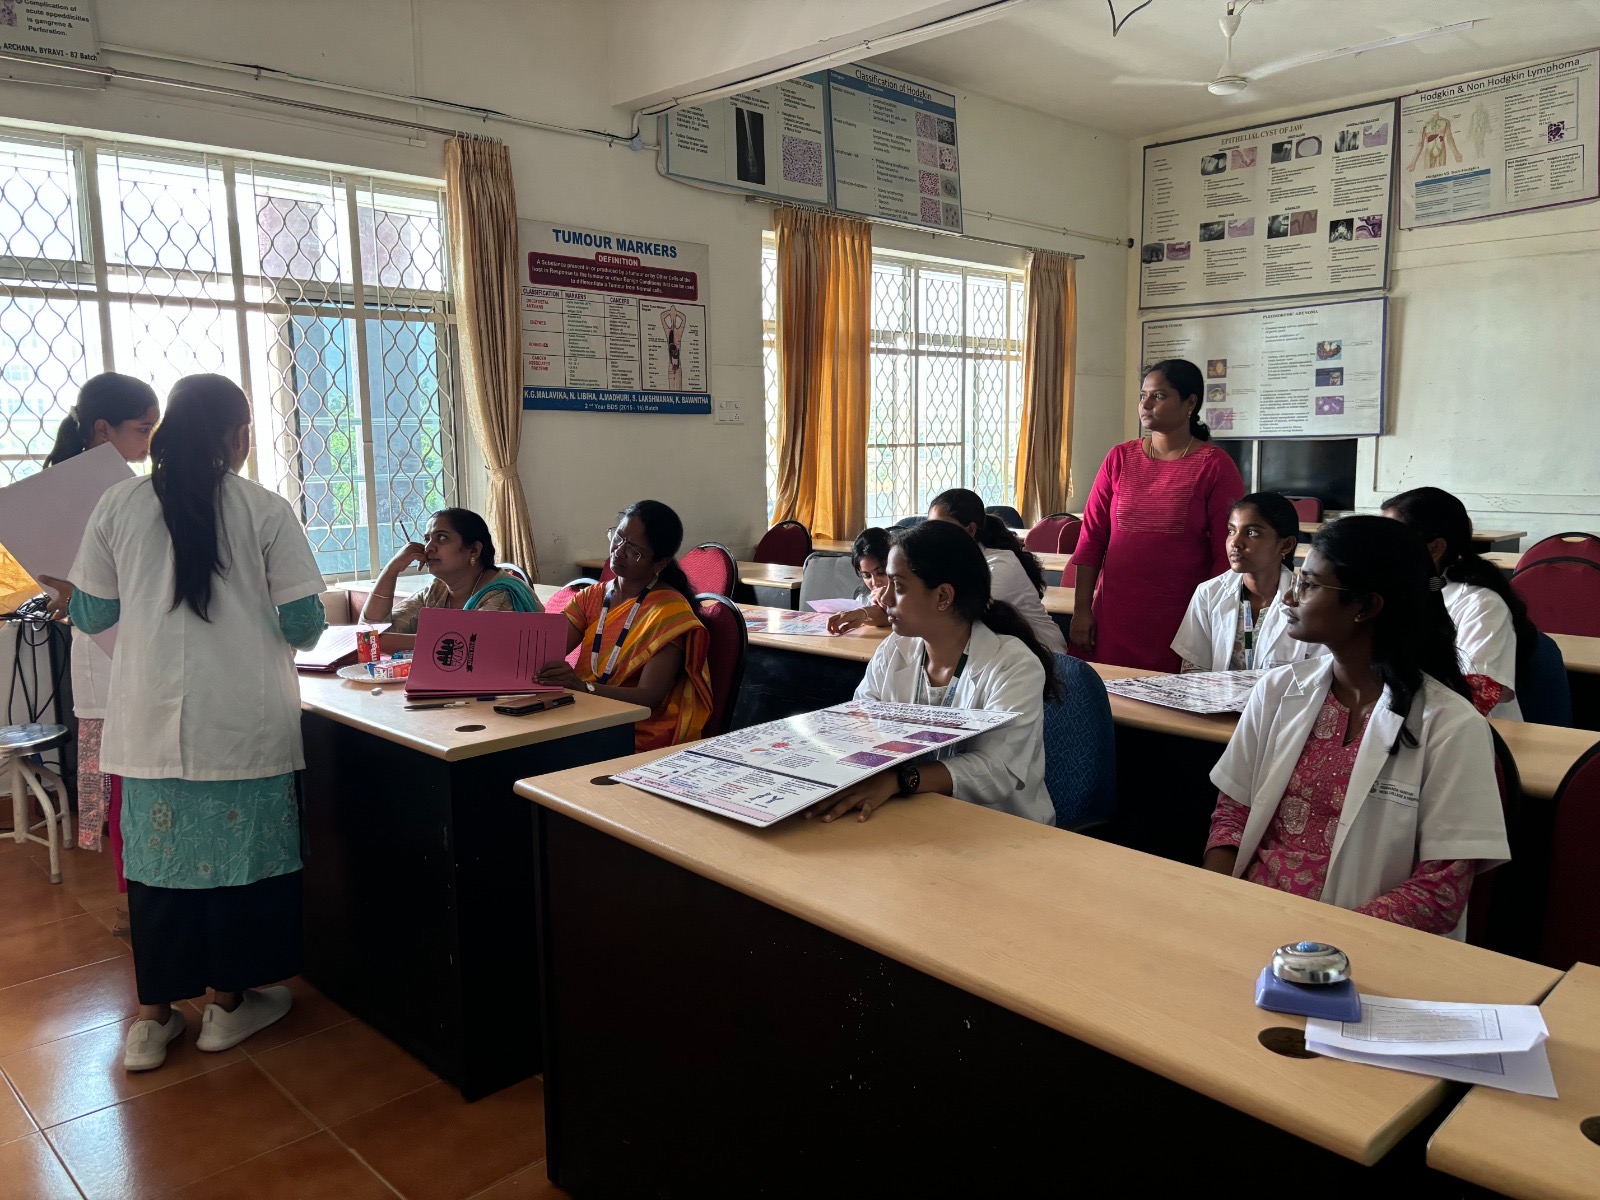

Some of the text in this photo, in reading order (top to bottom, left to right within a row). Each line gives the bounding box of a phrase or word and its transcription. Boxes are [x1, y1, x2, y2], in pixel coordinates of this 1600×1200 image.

[4, 42, 37, 54] ARCHANA,
[39, 47, 64, 57] BYRAVI
[855, 69, 898, 90] Classification
[900, 83, 906, 92] of
[907, 86, 932, 100] Hodgkin
[1420, 58, 1580, 102] Hodgkin & Non Hodgkin Lymphoma
[1221, 132, 1260, 145] EPITHELIAL
[1260, 128, 1278, 138] CYST
[1279, 126, 1289, 134] OF
[552, 229, 677, 258] TUMOUR MARKERS
[598, 255, 638, 267] DEFINITION
